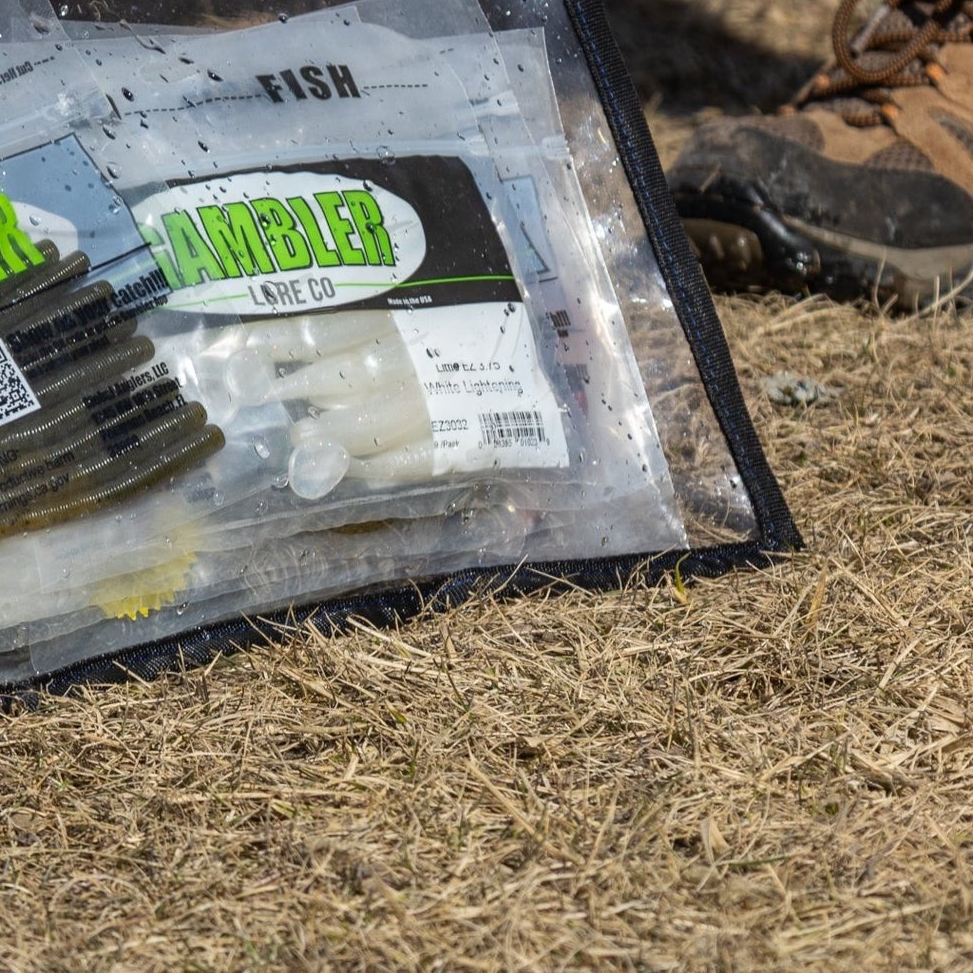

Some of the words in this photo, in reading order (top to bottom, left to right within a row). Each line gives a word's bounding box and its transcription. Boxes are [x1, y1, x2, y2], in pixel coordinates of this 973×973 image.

[255, 64, 362, 104] FISH
[307, 276, 336, 303] CO
[151, 360, 170, 378] LLC
